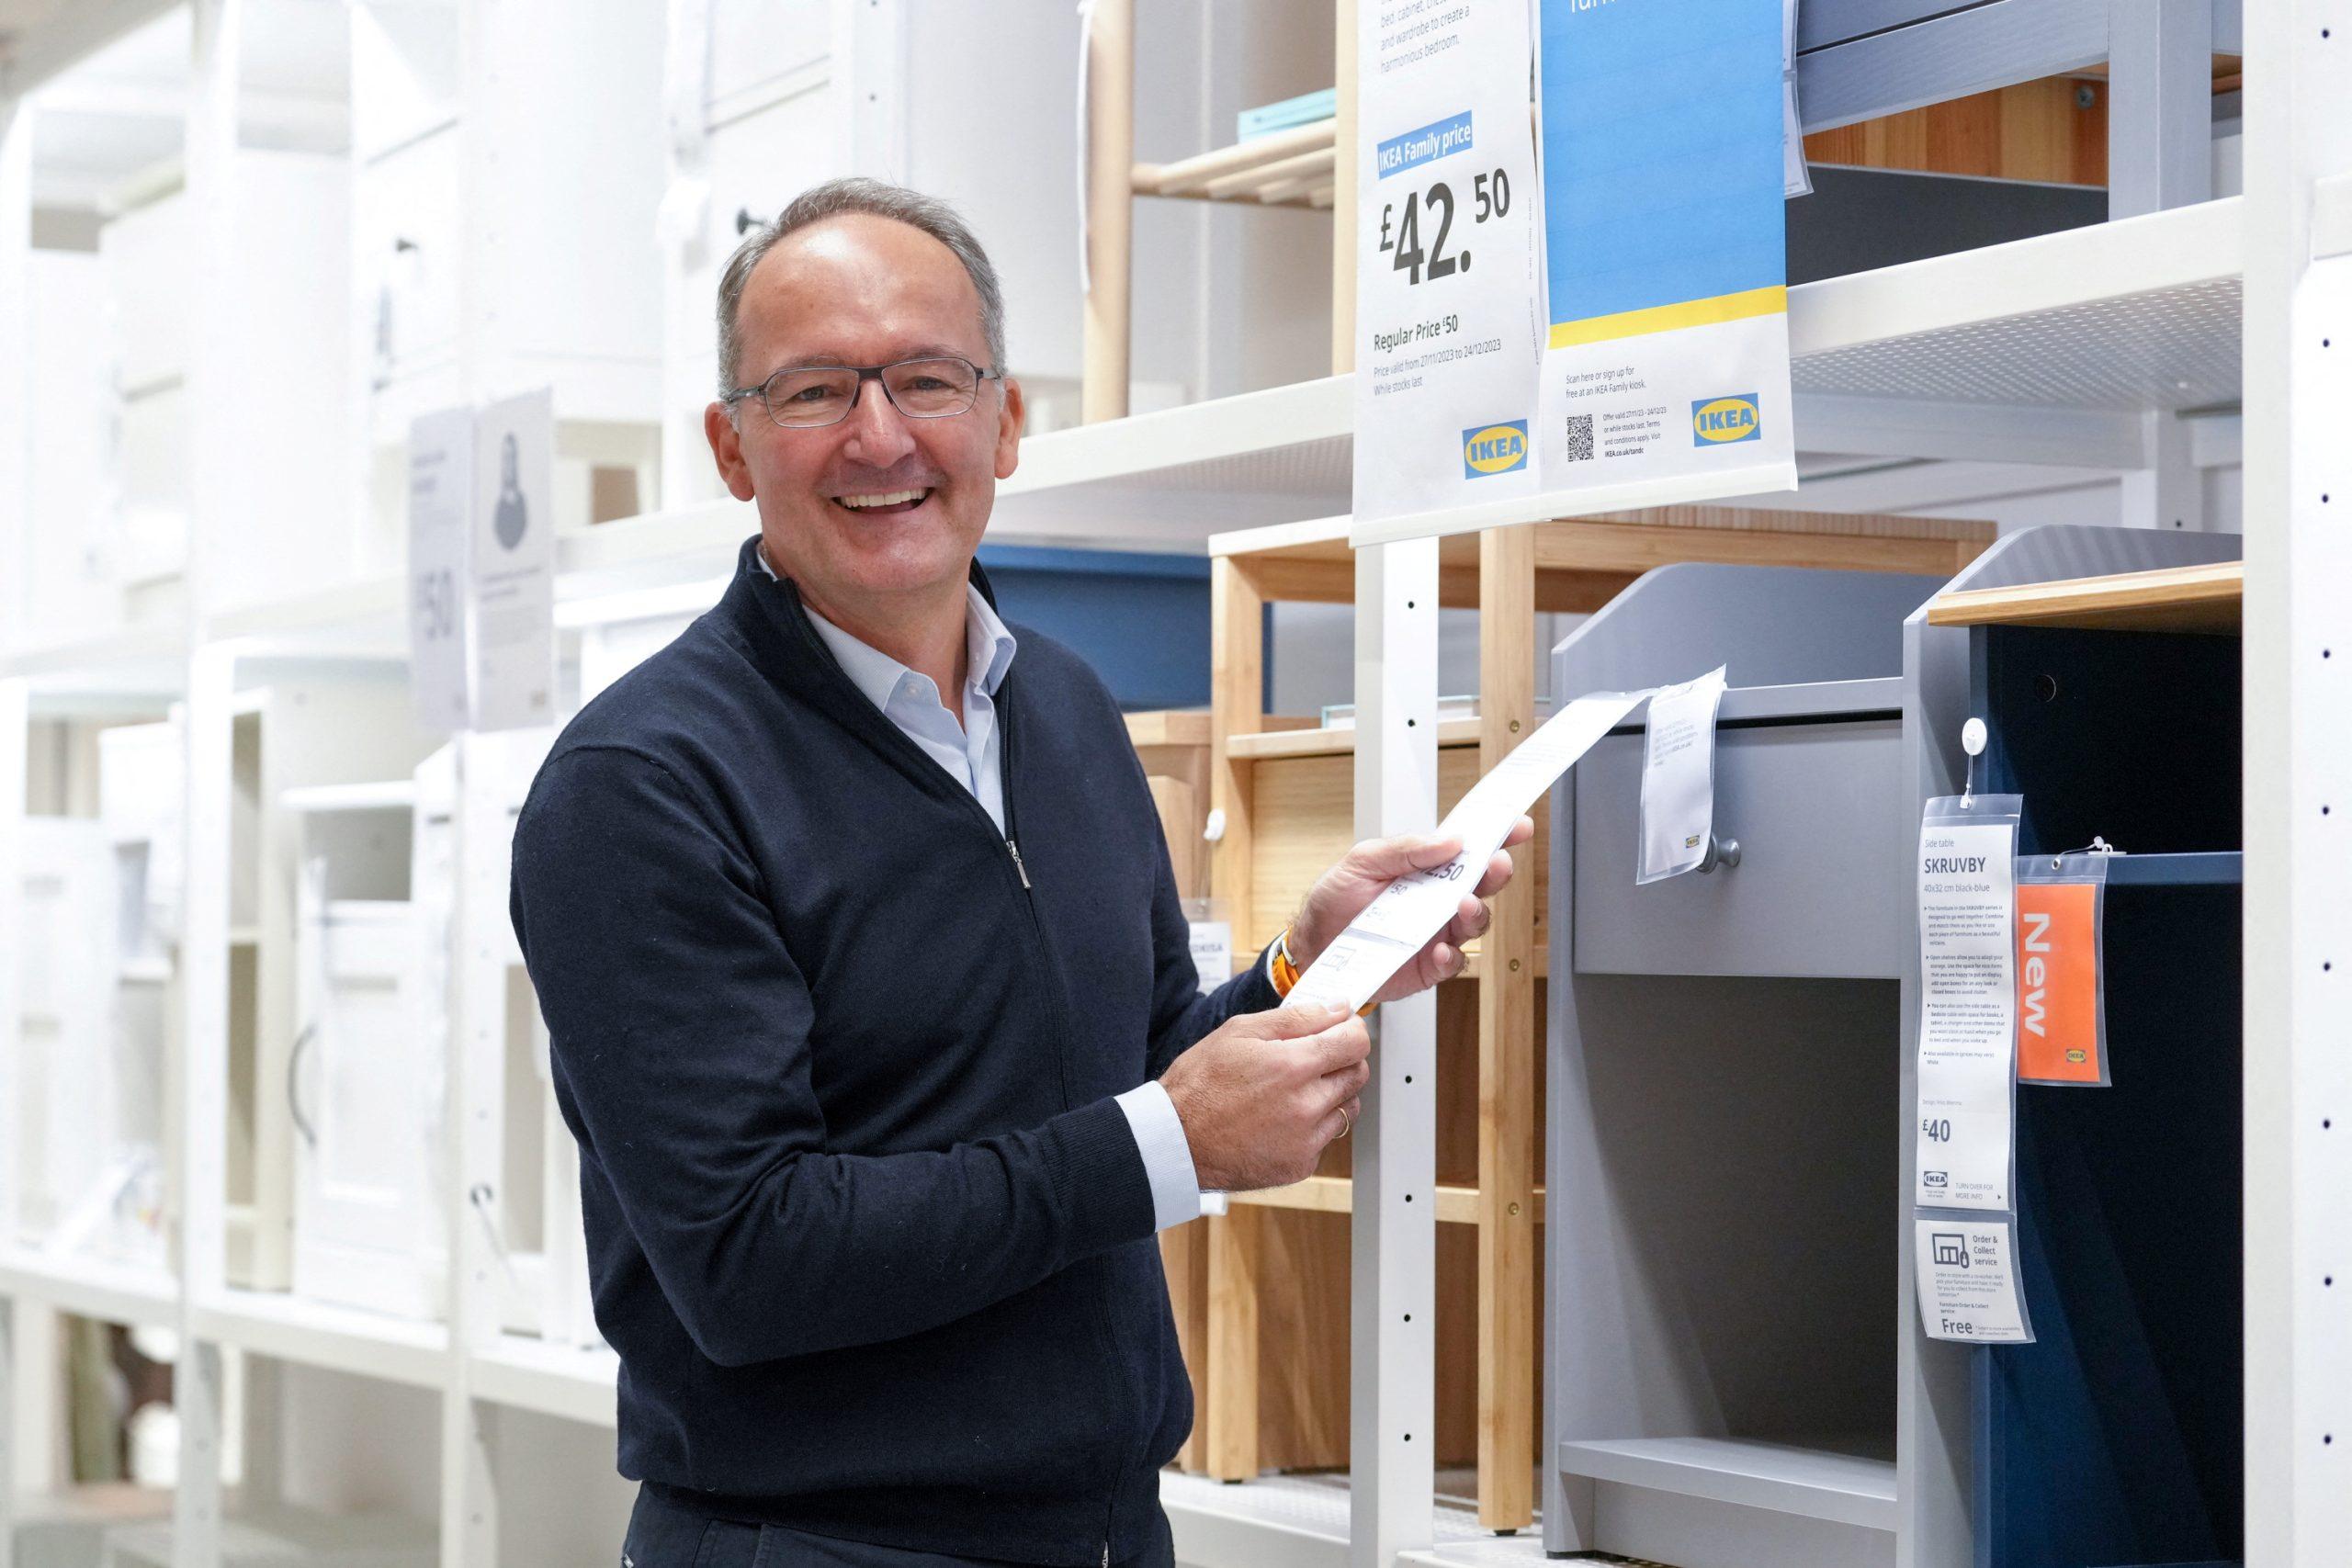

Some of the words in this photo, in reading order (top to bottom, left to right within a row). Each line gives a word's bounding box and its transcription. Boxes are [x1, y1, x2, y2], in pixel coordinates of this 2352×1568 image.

[1381, 35, 1395, 51] and
[1396, 21, 1430, 44] wardrobe
[1430, 18, 1439, 29] to
[1441, 9, 1463, 27] create
[1465, 6, 1469, 17] a
[1381, 48, 1423, 73] harmonious
[1425, 34, 1459, 57] bedroom.
[1379, 146, 1402, 171] IKEA
[1405, 132, 1441, 162] Family
[1442, 124, 1470, 154] price
[1374, 327, 1413, 353] Regular
[1416, 321, 1441, 341] Price
[1374, 366, 1389, 378] Price
[1390, 361, 1404, 374] valid
[1405, 358, 1419, 370] from
[1420, 349, 1453, 367] 27/11/2023
[1455, 349, 1463, 359] to
[1464, 339, 1501, 357] 24/12/2023
[1374, 383, 1391, 396] While
[1393, 378, 1410, 391] stocks
[1412, 377, 1422, 387] last
[1566, 374, 1580, 384] Scan
[1581, 372, 1594, 382] here
[1596, 372, 1601, 380] or
[1603, 369, 1615, 380] sign
[1617, 369, 1624, 378] up
[1626, 366, 1634, 376] for
[1566, 388, 1577, 398] free
[1578, 387, 1585, 397] at
[1587, 388, 1593, 396] an
[1595, 385, 1608, 394] IKEA
[1610, 382, 1628, 394] Family
[1700, 408, 1754, 432] IKEA
[1471, 435, 1522, 462] IKEA
[1925, 840, 1937, 848] Side
[1939, 839, 1954, 847] table
[1925, 857, 1985, 873] SKRUVBY
[1955, 884, 1990, 892] black-blue
[2023, 913, 2051, 1038] New
[1923, 1119, 1950, 1142] £40
[1973, 1247, 1996, 1255] Collect
[1942, 1318, 1973, 1334] Free
